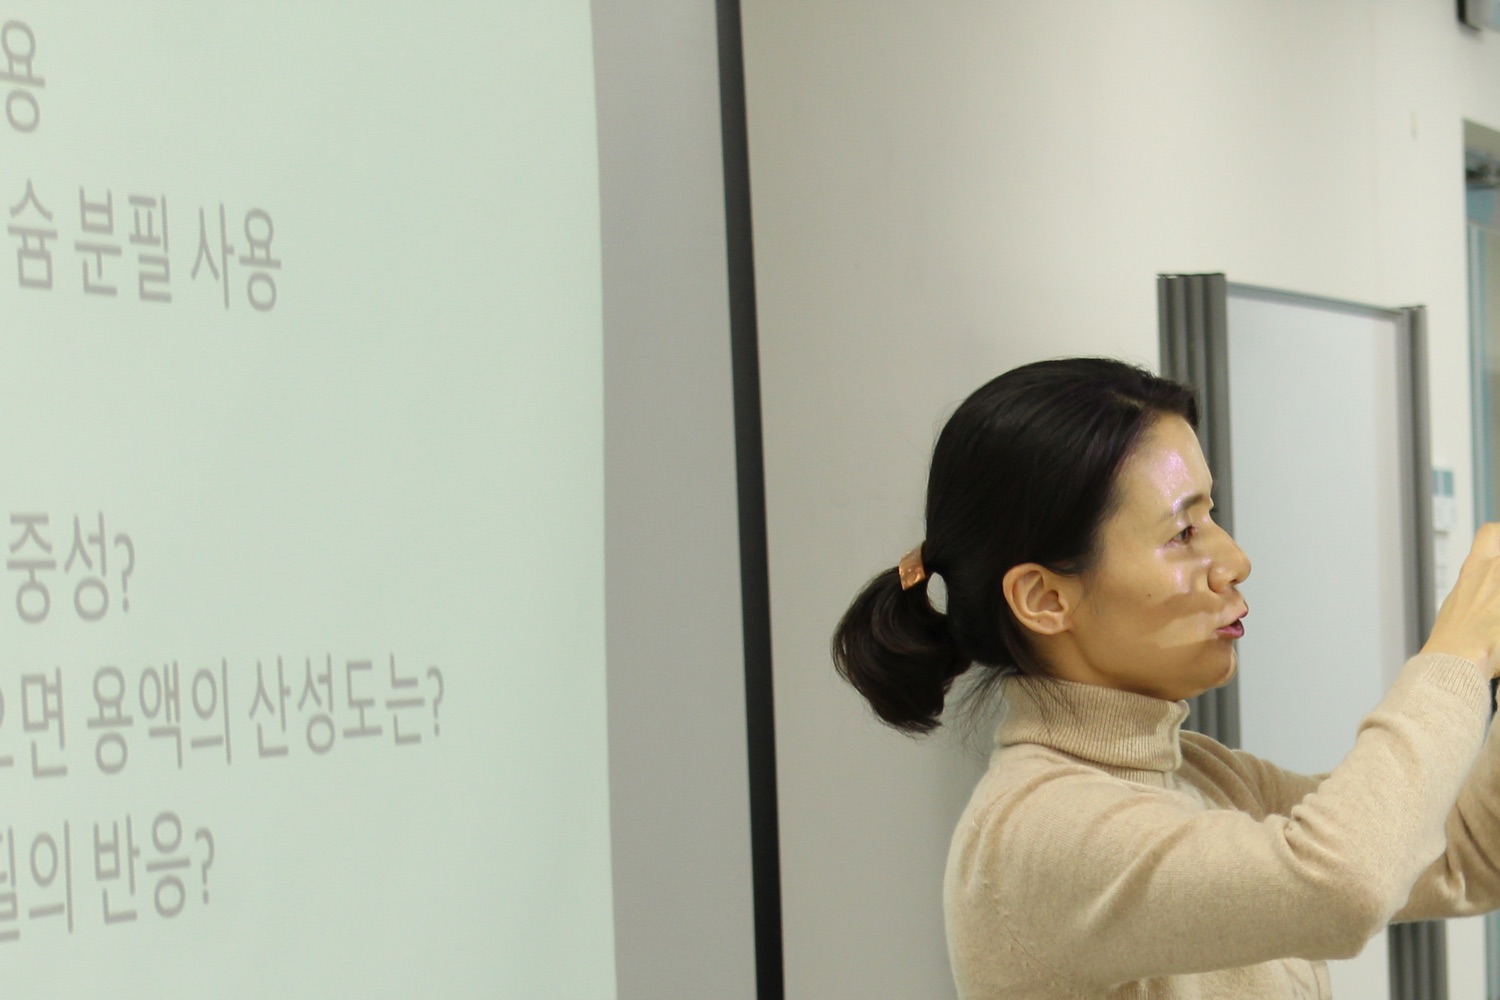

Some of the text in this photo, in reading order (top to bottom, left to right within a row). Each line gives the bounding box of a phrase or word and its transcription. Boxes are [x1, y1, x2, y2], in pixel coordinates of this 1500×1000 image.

[0, 20, 45, 133] 용
[8, 179, 281, 312] 슘 분필 사용
[7, 511, 135, 624] 중성?
[87, 658, 231, 775] 용액의
[249, 653, 444, 758] 산성도는?
[93, 811, 214, 925] 반응?
